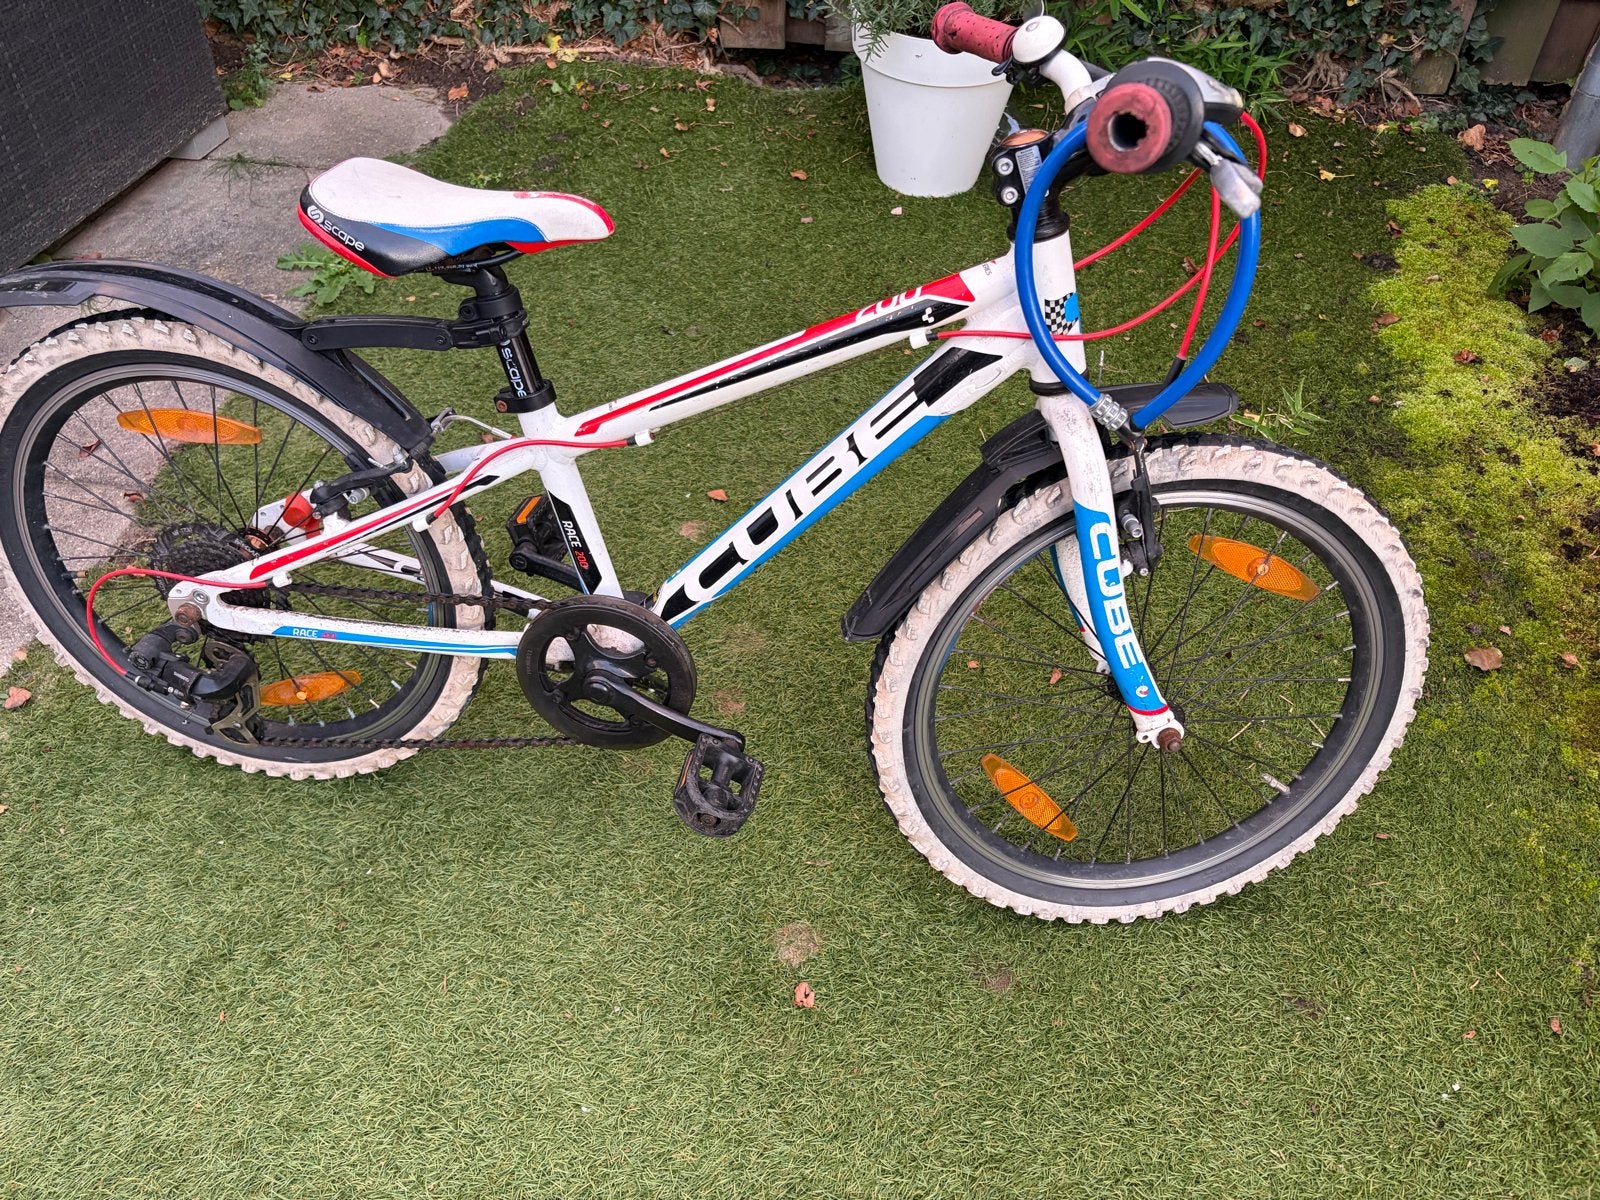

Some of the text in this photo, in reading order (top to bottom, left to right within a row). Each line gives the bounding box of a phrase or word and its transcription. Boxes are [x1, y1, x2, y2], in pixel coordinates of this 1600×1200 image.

[683, 377, 930, 603] CUBE
[561, 520, 590, 570] RACE 200
[292, 627, 319, 638] RACE
[1089, 521, 1144, 670] CUBE
